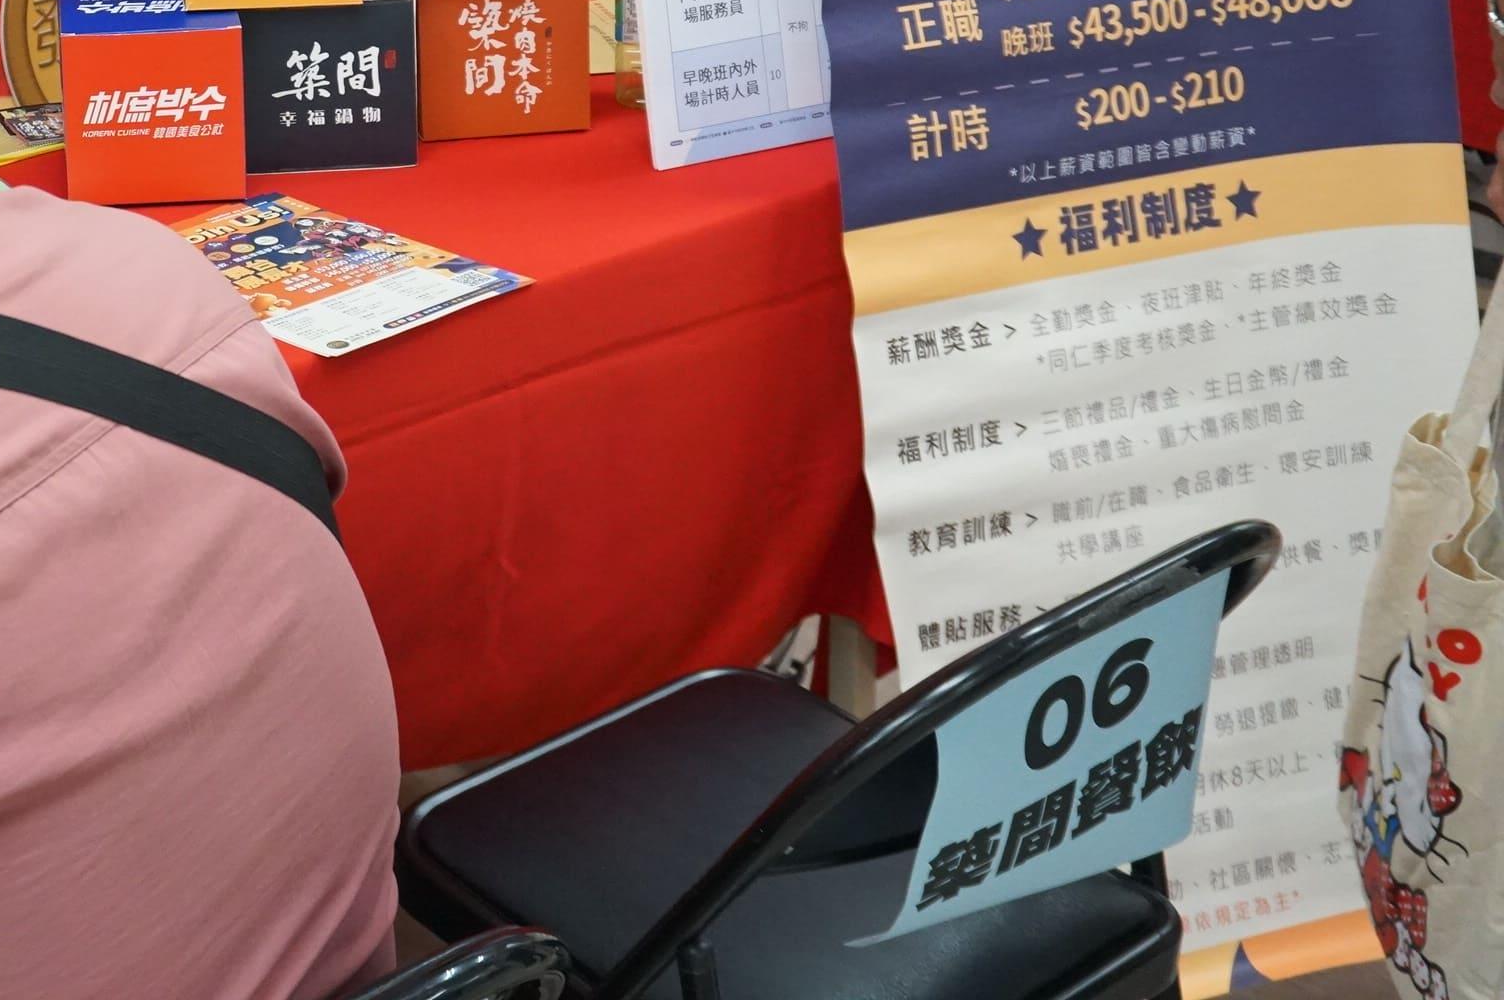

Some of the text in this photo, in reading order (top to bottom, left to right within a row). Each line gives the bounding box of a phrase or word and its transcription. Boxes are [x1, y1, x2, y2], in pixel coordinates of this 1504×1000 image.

[684, 0, 744, 23] 場服務員
[1001, 19, 1055, 58] 晚班
[271, 41, 381, 100] 築間
[683, 59, 757, 86] 早晚班內外
[770, 69, 781, 80] 10
[279, 106, 382, 127] 幸福鍋物
[684, 80, 760, 108] 場計時人員
[82, 123, 224, 139] KOREAN CUISINE 韓國美食公社
[907, 105, 990, 162] 計時
[186, 222, 239, 244] oin
[1059, 182, 1223, 256] 福利制度
[886, 321, 993, 366] 薪酬獎金
[897, 420, 1003, 465] 福利制度
[908, 510, 1012, 558] 教育訓練
[918, 604, 1021, 652] 體貼服務
[1024, 637, 1154, 770] 06
[1215, 686, 1351, 738] 勞退提繳、健
[915, 704, 1203, 912] 築間餐飲
